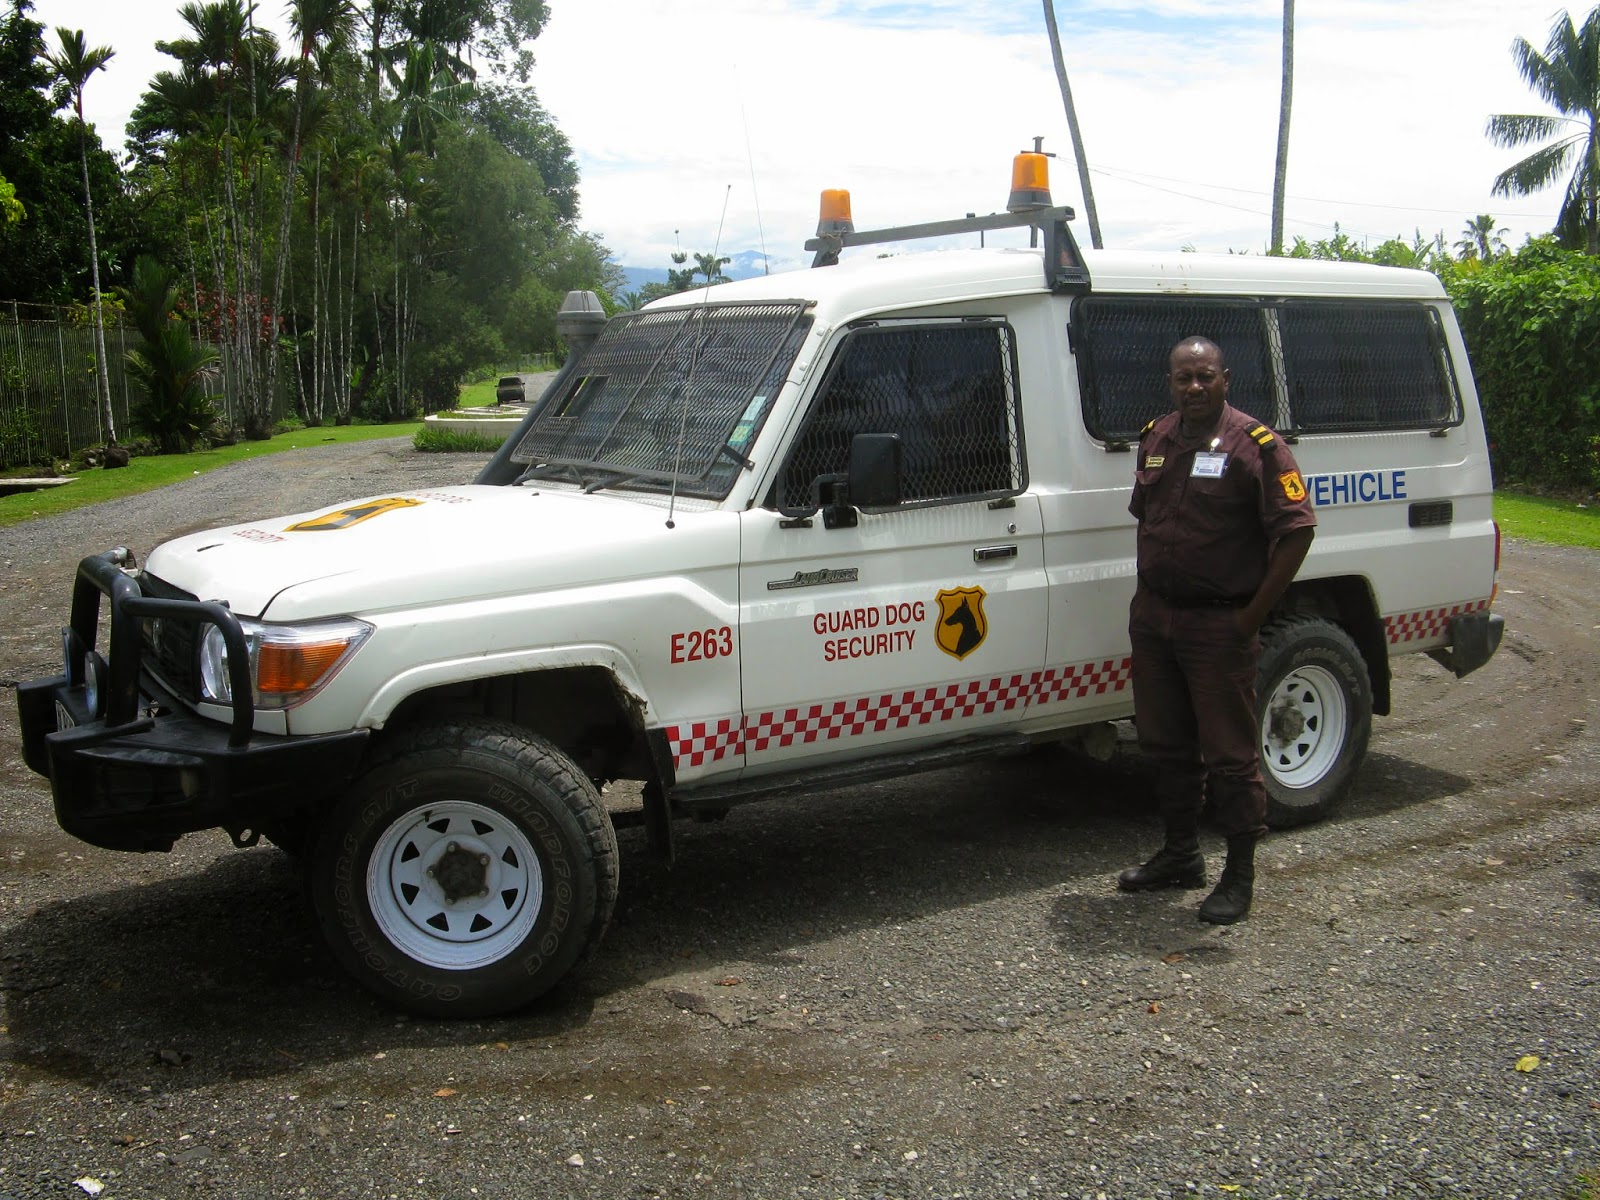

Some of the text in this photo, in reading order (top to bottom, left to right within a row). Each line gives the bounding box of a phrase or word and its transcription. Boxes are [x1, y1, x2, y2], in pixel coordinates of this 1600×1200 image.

[813, 600, 925, 635] GUARD DOG
[670, 626, 733, 664] E263
[824, 629, 916, 662] SECURITY
